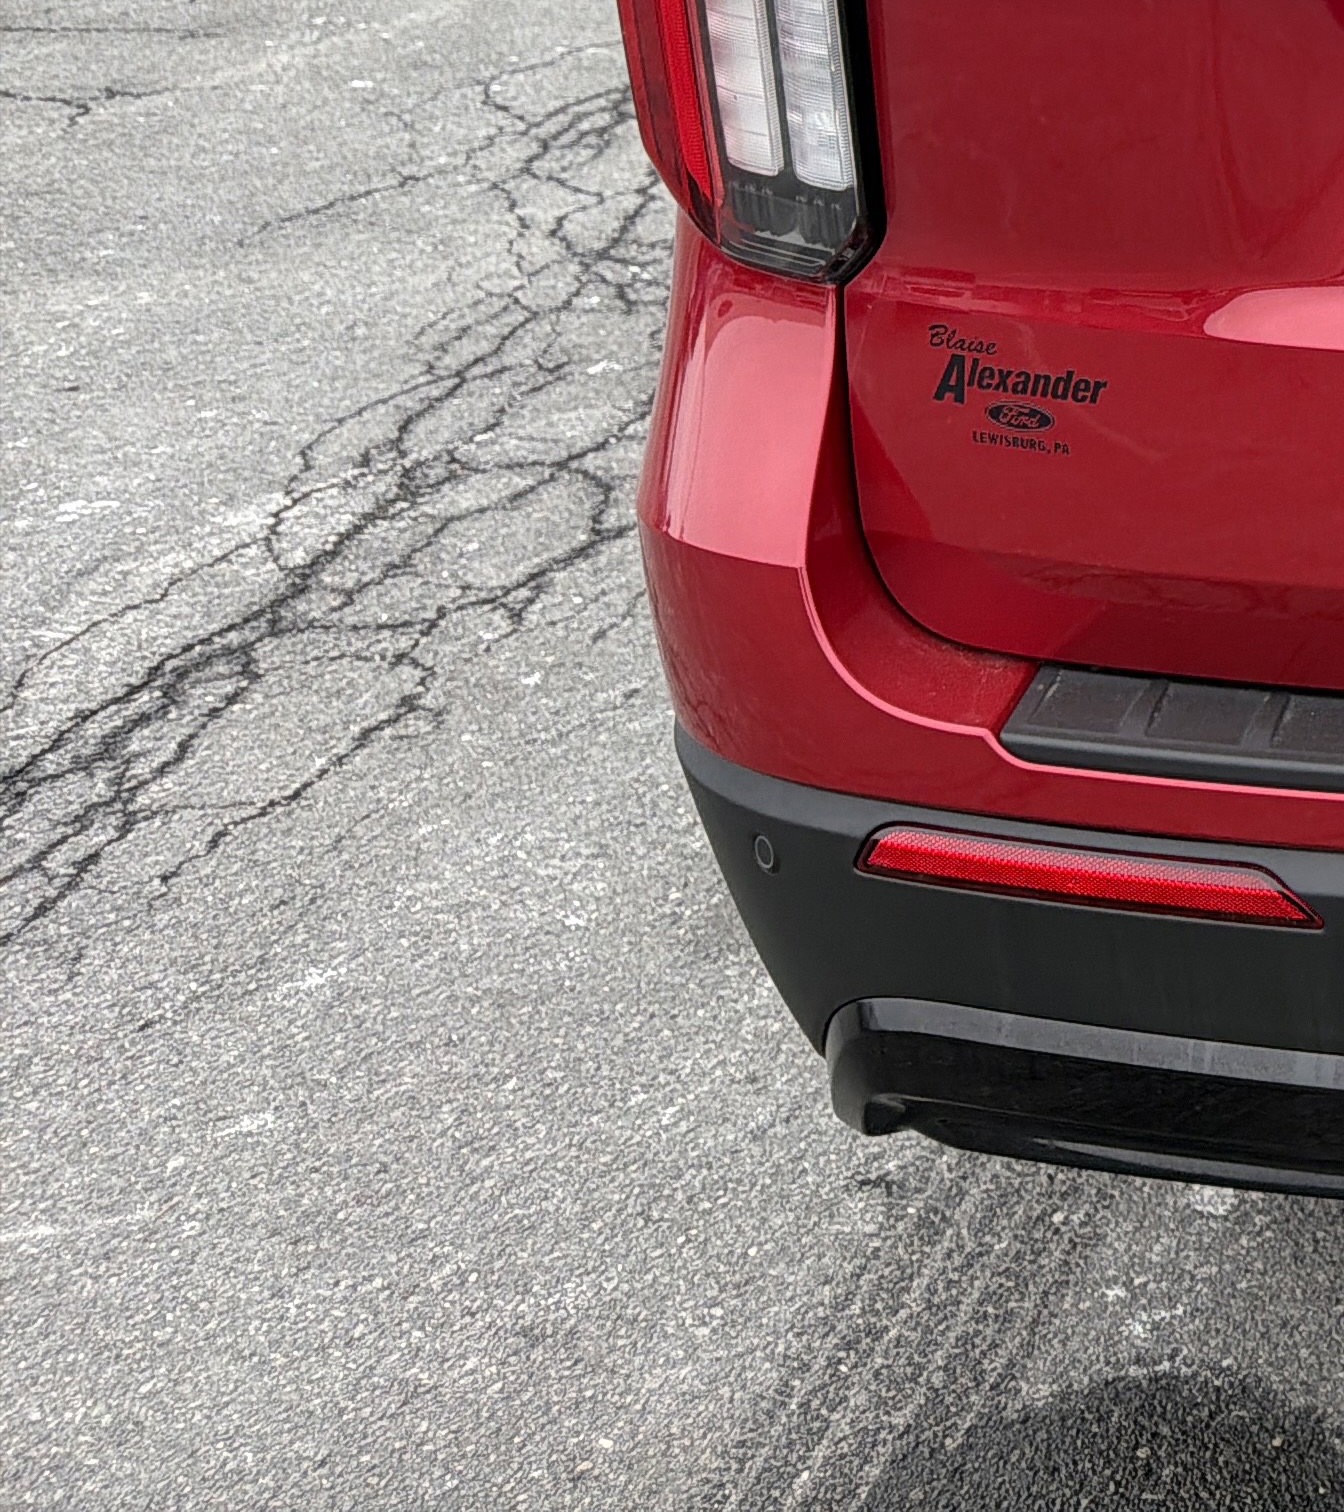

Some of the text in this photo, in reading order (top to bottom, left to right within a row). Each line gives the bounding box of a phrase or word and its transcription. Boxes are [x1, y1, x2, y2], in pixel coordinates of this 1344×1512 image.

[928, 324, 997, 355] Blaise
[933, 354, 1108, 405] Alexander
[1000, 404, 1042, 429] Ford
[972, 430, 1071, 456] LEWISBURG, PA
